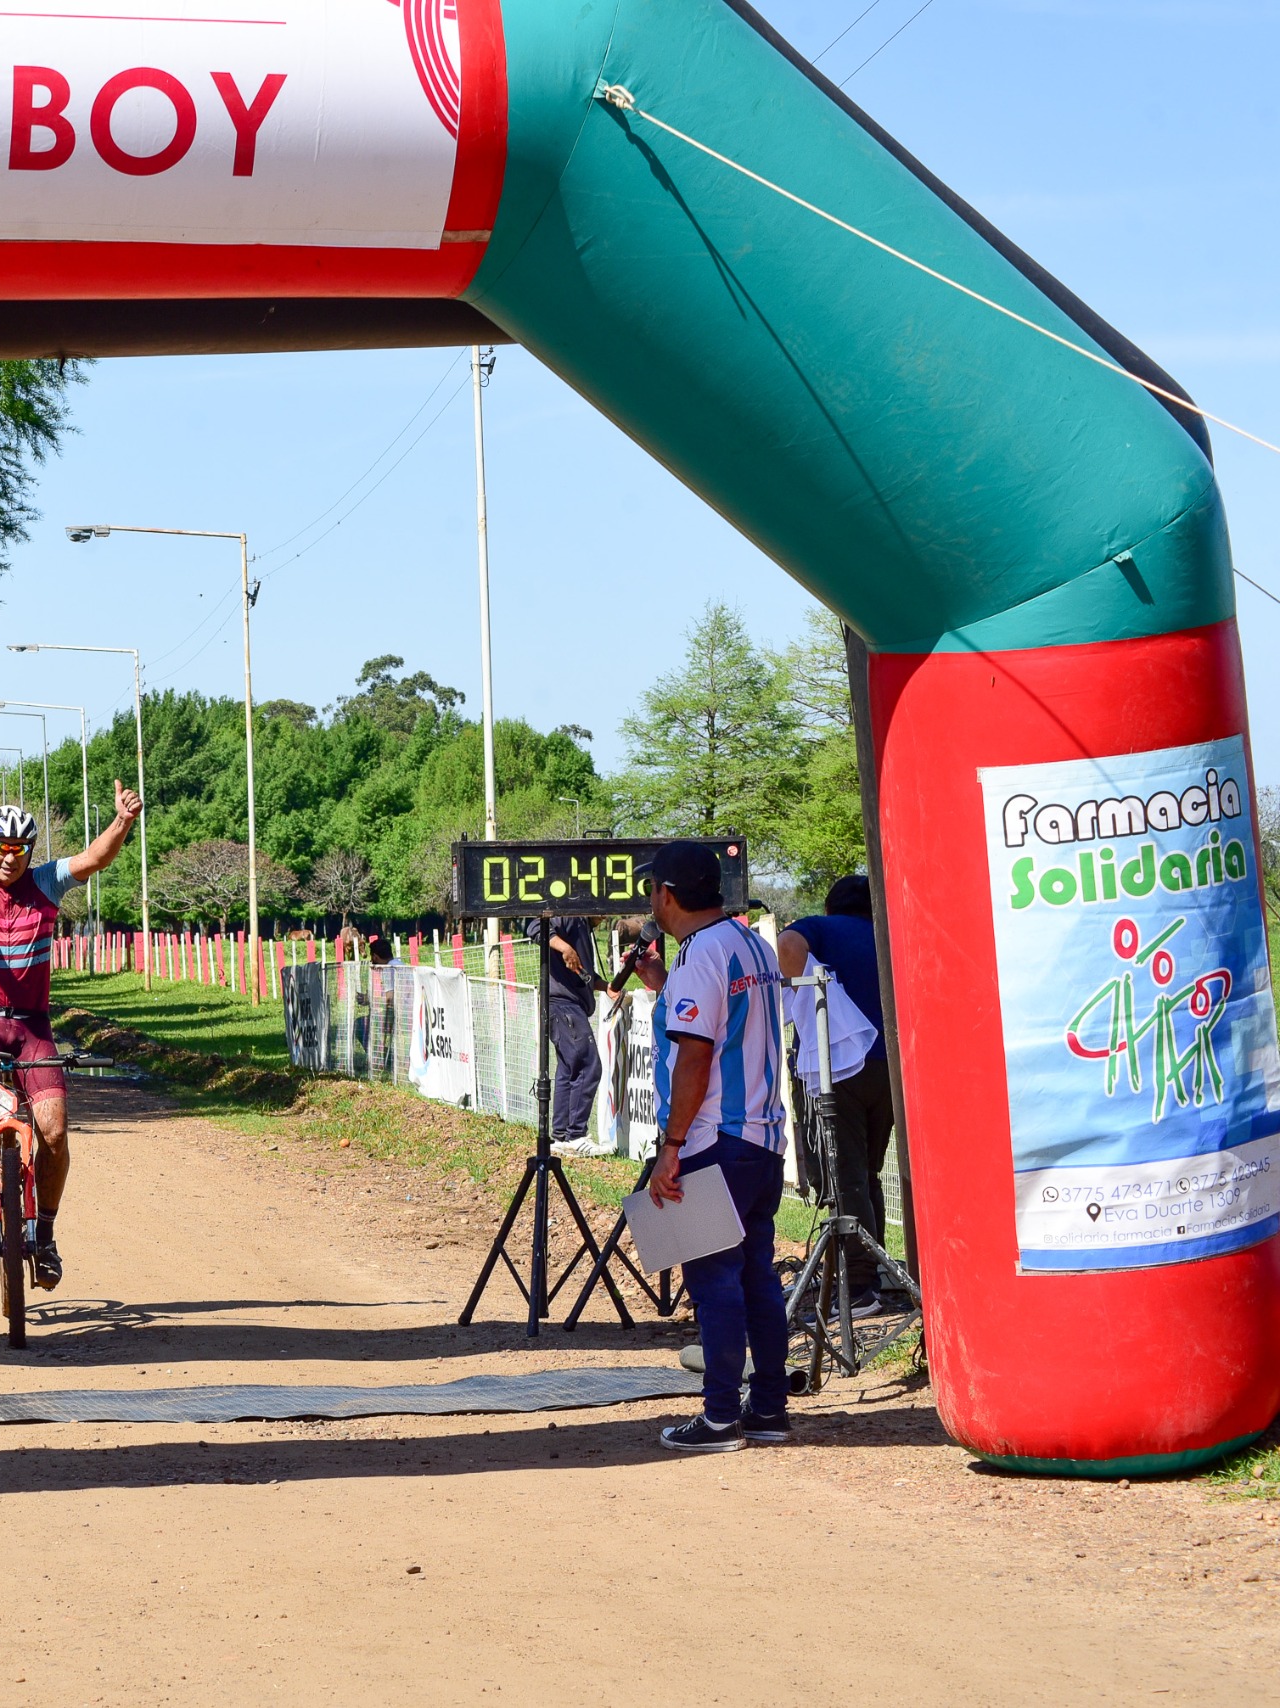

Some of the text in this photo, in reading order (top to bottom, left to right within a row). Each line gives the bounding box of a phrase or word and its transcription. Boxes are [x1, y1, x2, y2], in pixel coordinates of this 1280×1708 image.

[1002, 768, 1242, 847] Farmacia
[1010, 830, 1247, 910] Solidaria
[628, 1087, 656, 1126] CASERO
[1061, 1186, 1105, 1203] 3775
[1111, 1180, 1171, 1201] 473471
[1191, 1172, 1227, 1192] 3775
[1104, 1187, 1241, 1223] Eva Duarte 1309
[1186, 1214, 1237, 1234] Farmacia
[1239, 1202, 1270, 1223] Solidaria
